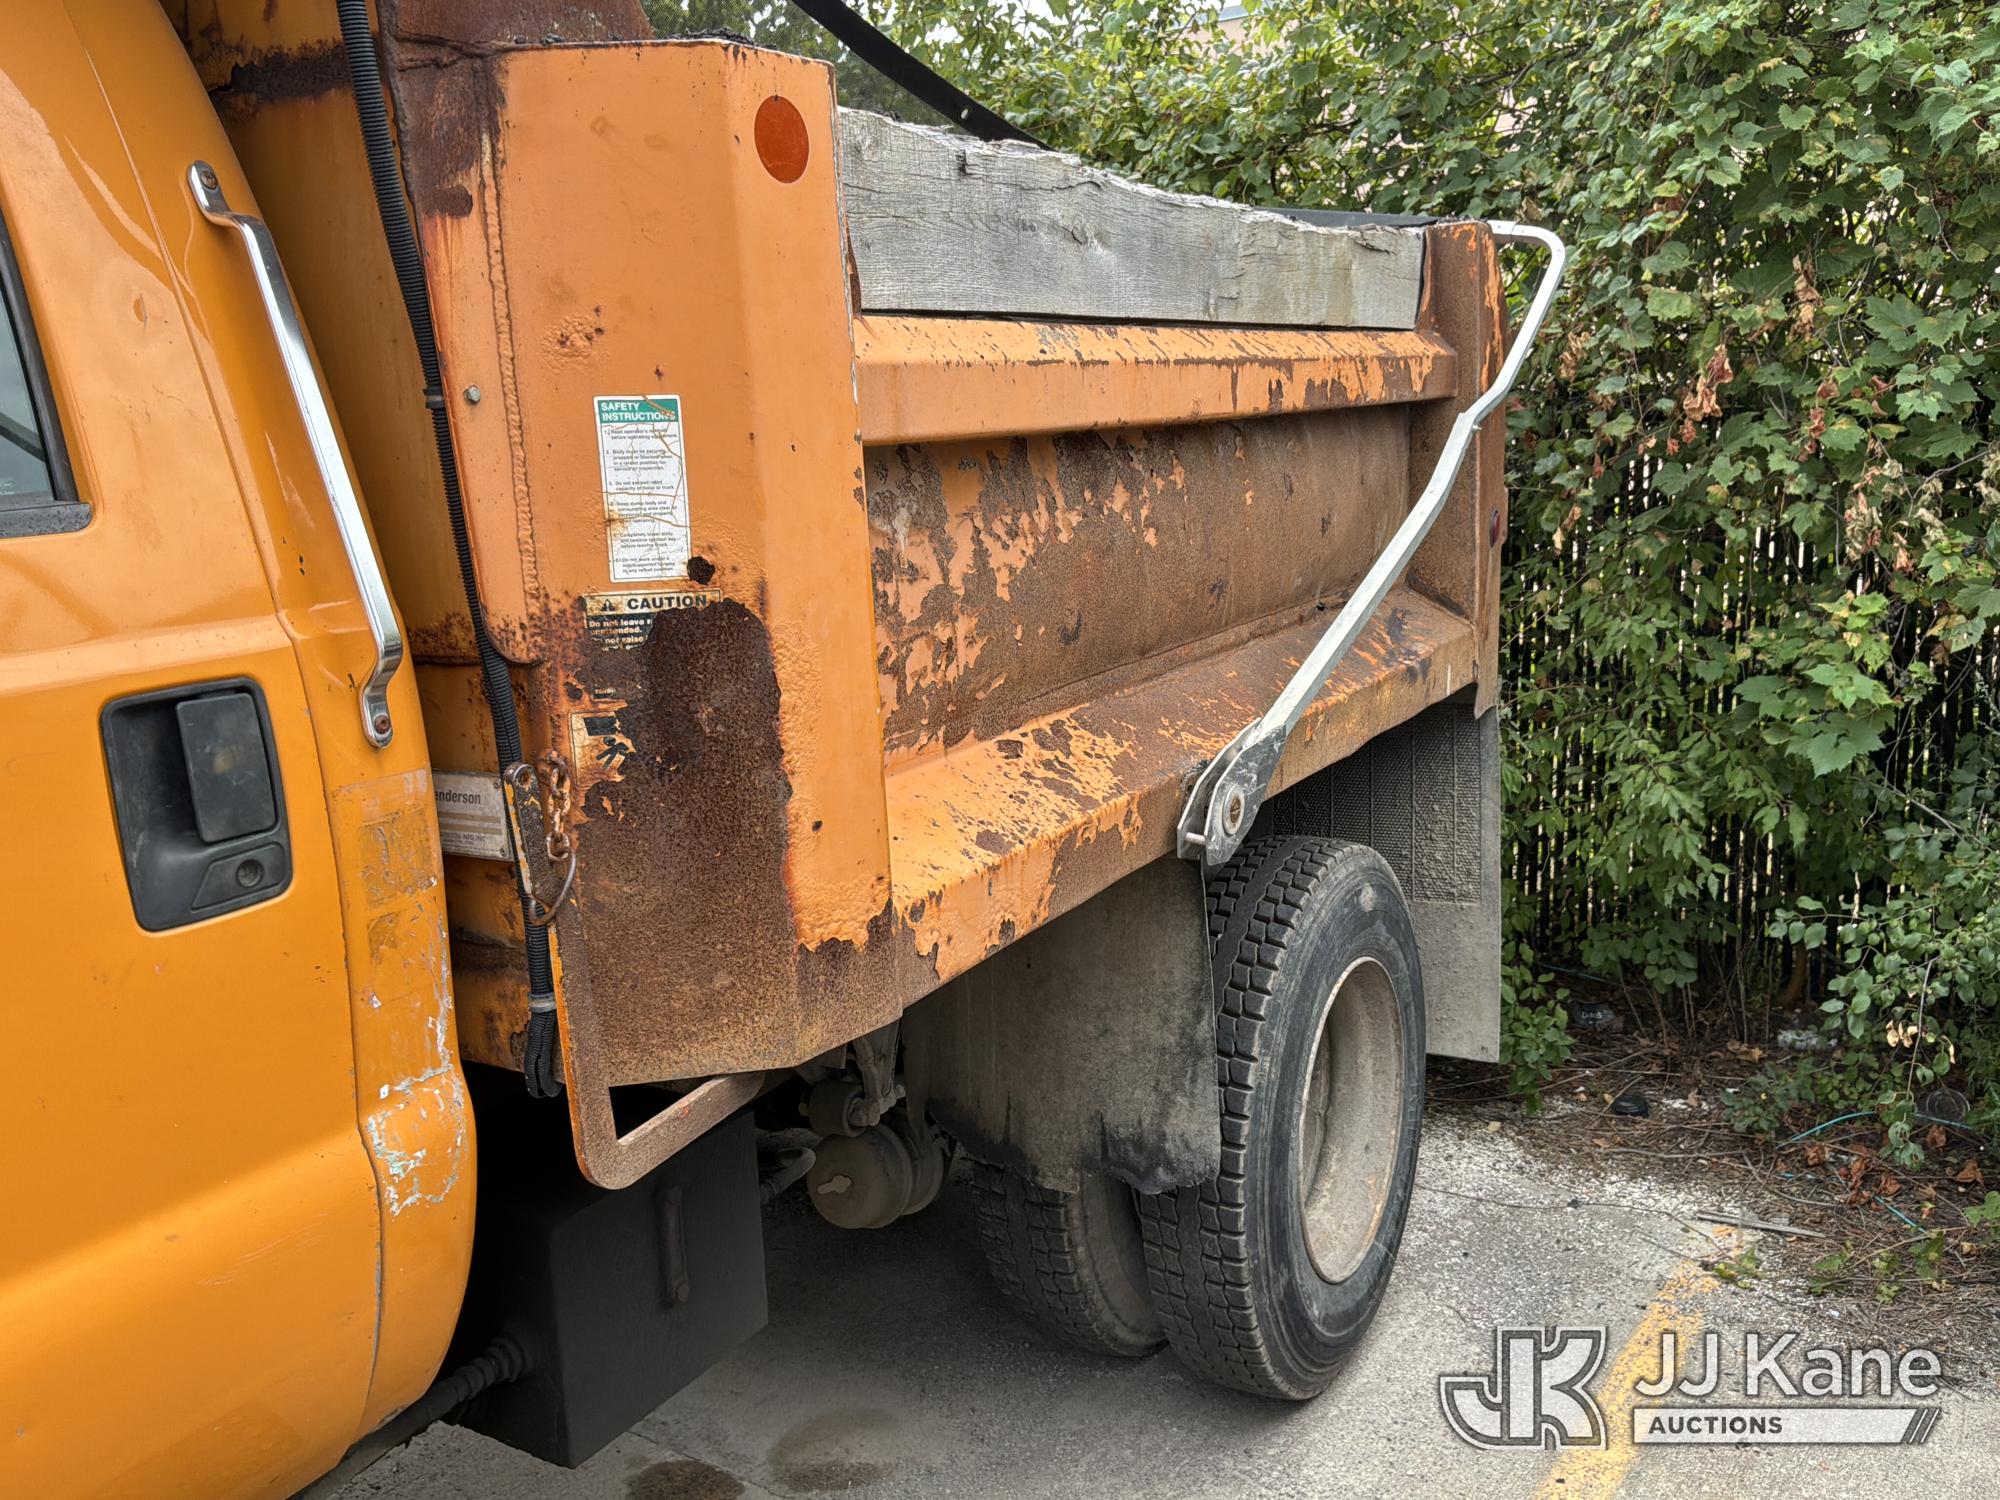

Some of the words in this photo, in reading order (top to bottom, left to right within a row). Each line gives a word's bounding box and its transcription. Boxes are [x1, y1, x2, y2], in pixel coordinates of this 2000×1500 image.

[601, 402, 640, 411] SAFETY
[602, 411, 676, 421] INSTRUCTIONS
[627, 594, 707, 610] CAUTION
